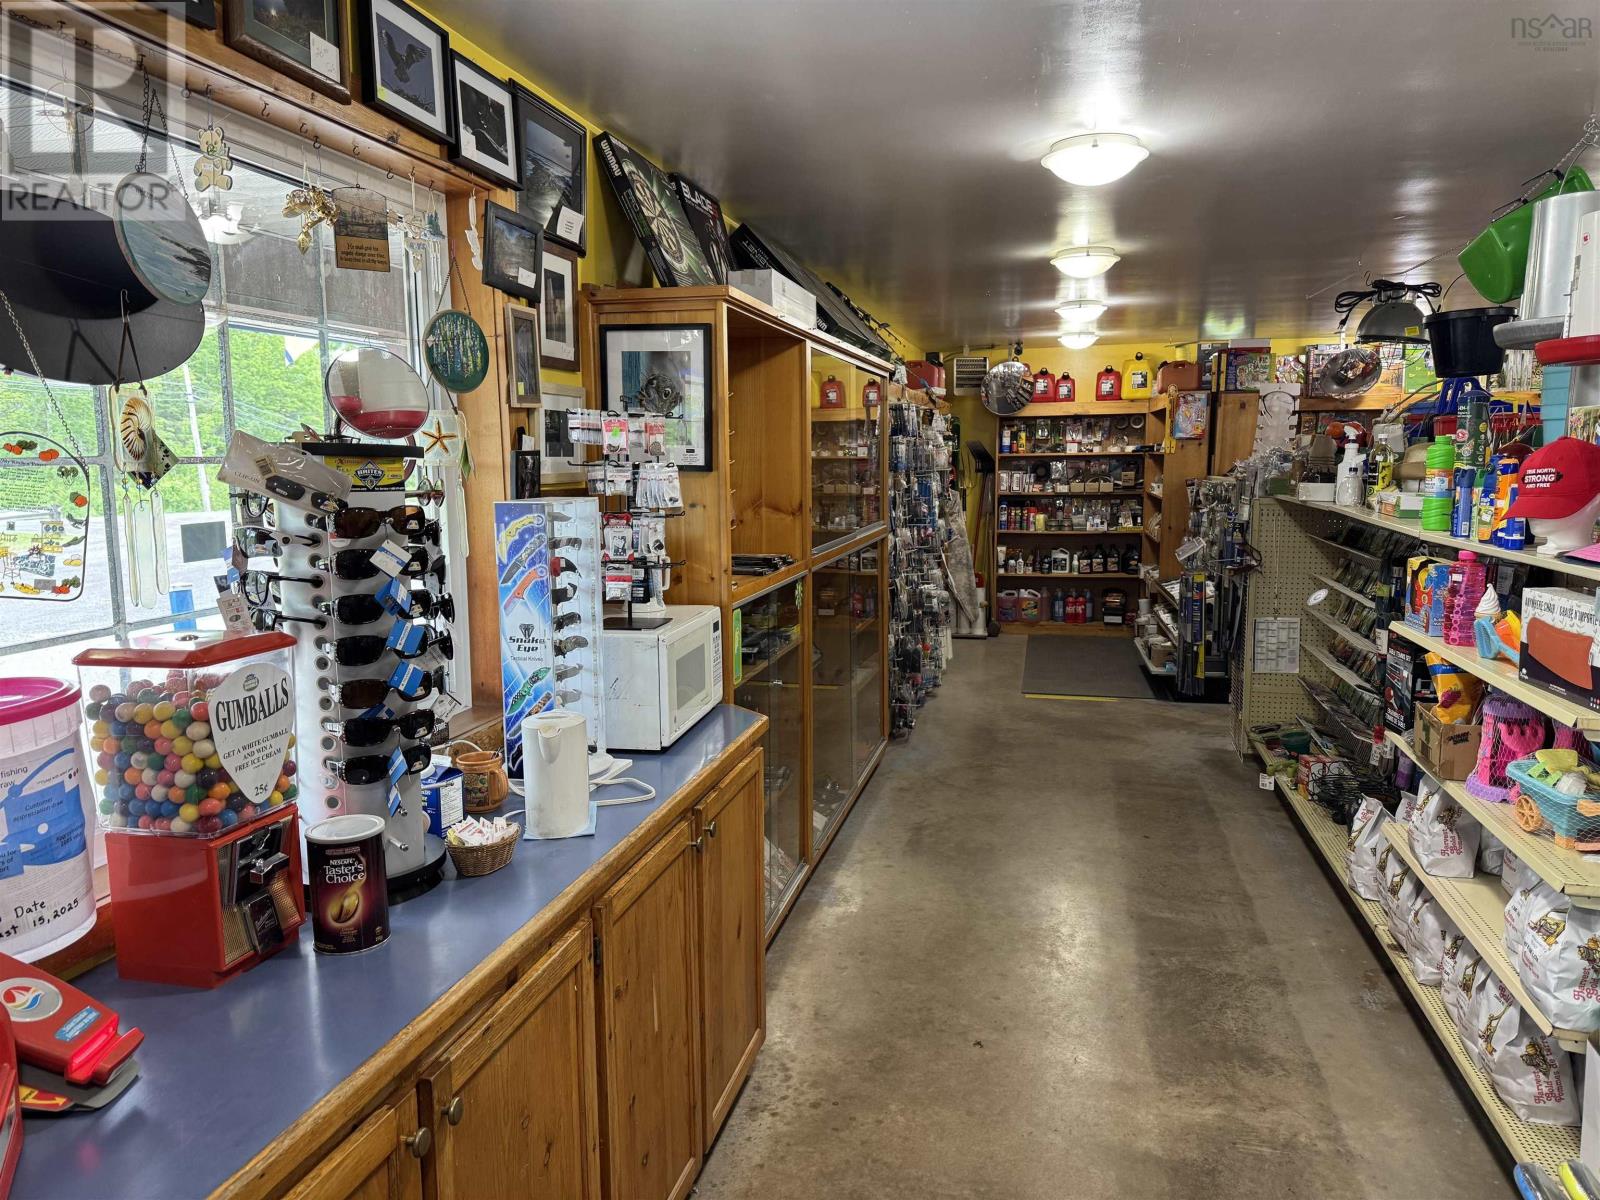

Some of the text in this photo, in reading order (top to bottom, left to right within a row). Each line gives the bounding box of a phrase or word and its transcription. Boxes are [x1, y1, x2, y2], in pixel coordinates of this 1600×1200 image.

[600, 139, 621, 177] WINMAU
[1524, 474, 1555, 483] STRONG
[508, 636, 545, 644] Snake
[517, 644, 538, 652] Eye
[216, 677, 289, 732] GUMBALLS
[224, 752, 236, 760] GET
[242, 740, 262, 752] WHITE
[262, 728, 288, 744] GUMBALL
[242, 752, 255, 760] AND
[256, 746, 268, 756] WIN
[234, 762, 250, 773] FREE
[250, 758, 260, 766] ICE
[261, 748, 282, 762] CREAM
[0, 766, 28, 780] fishing
[254, 784, 268, 796] 25¢
[13, 805, 50, 823] appreciation
[24, 798, 53, 812] Customer
[1440, 828, 1450, 857] Harvest
[324, 861, 364, 875] Taster's
[326, 872, 365, 884] Choice
[14, 900, 46, 918] Date
[1574, 966, 1590, 1002] Harvest
[1586, 978, 1598, 999] Gold
[1534, 1070, 1546, 1104] Harvest
